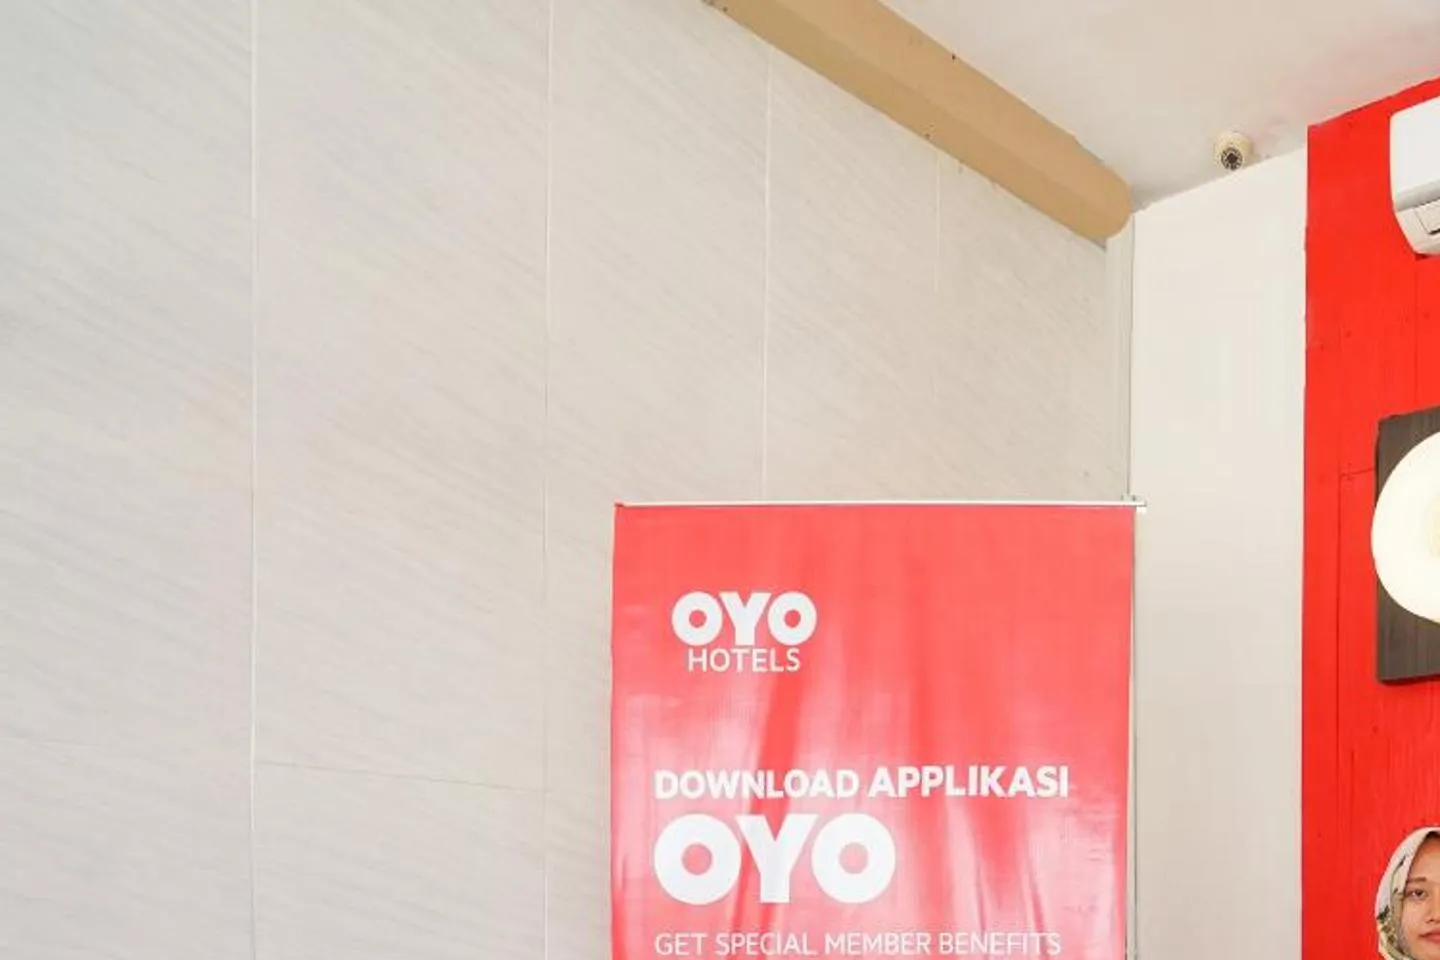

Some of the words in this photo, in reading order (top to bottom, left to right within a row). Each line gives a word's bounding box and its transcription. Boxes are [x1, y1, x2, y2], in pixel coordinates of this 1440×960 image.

[672, 591, 817, 645] OYO
[688, 648, 801, 672] HOTELS
[654, 769, 859, 799] DOWNLOAD
[868, 766, 1069, 797] APPLIKASI
[654, 813, 896, 905] OYO
[655, 932, 707, 956] GET
[715, 932, 816, 956] SPECIAL
[824, 932, 931, 956] MEMBER
[939, 932, 1061, 956] BENEFITS
